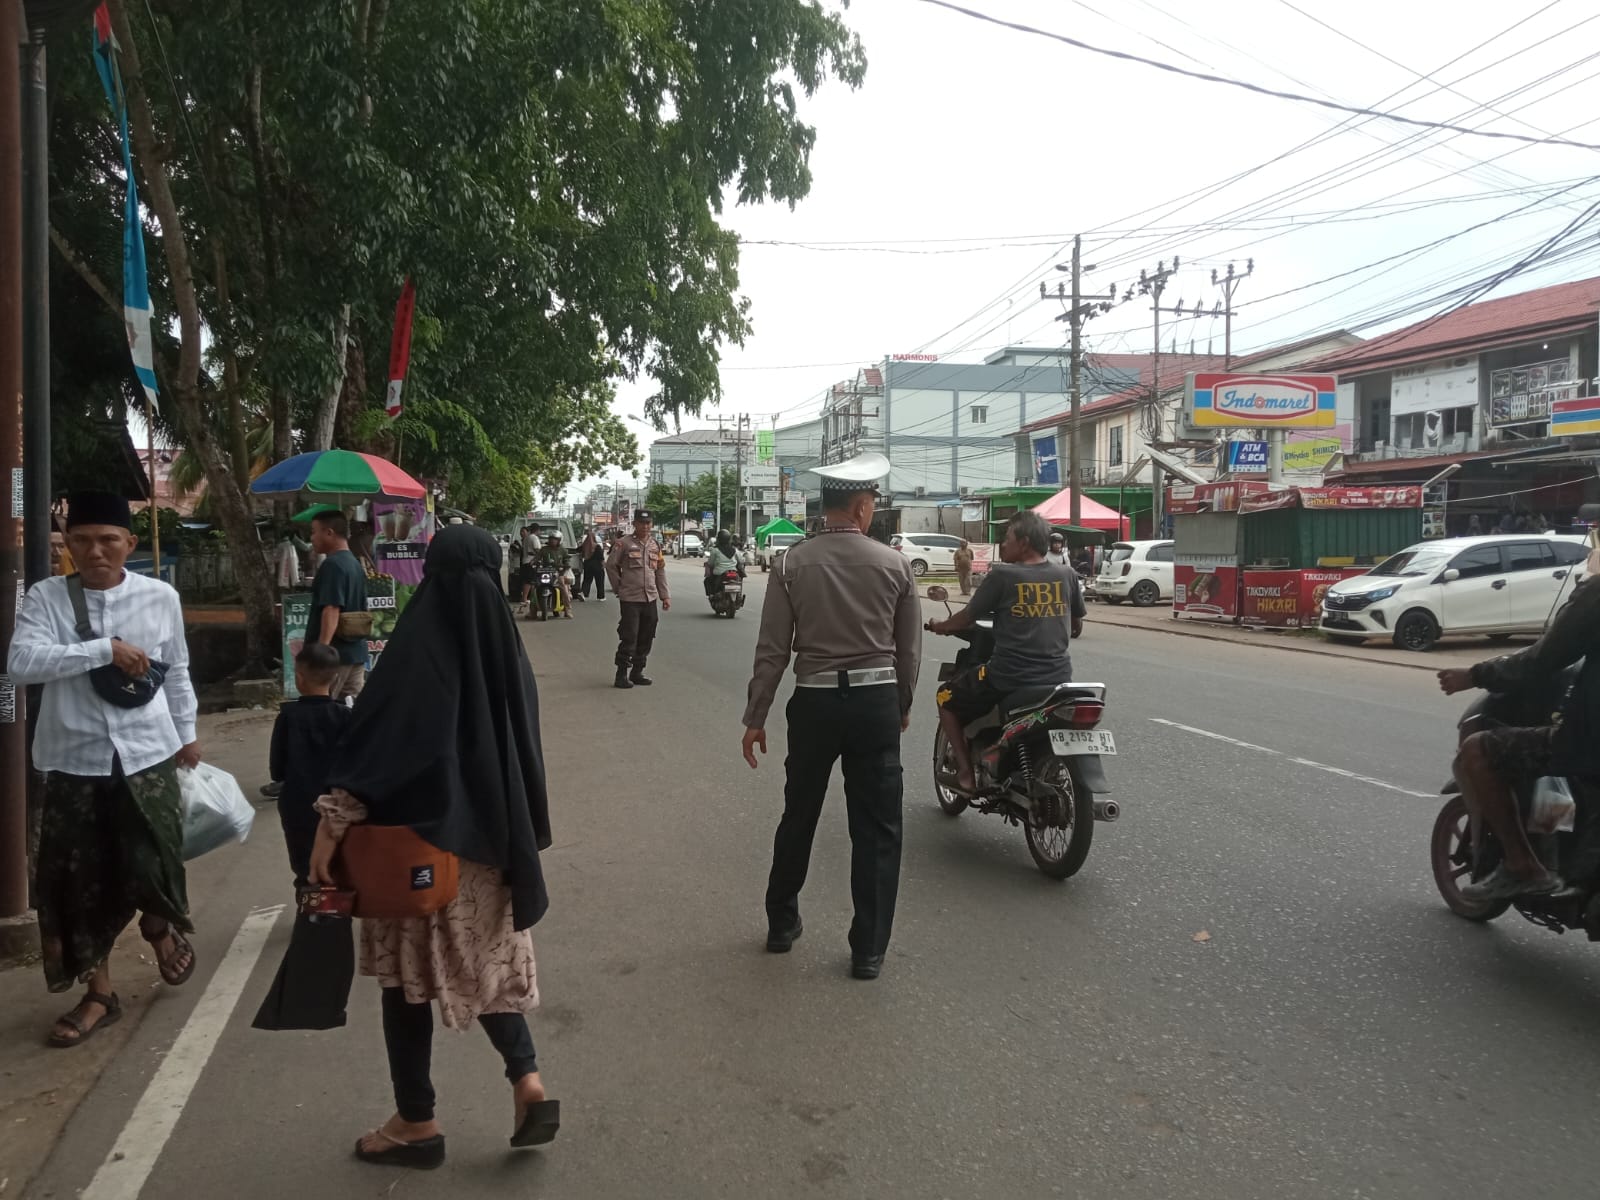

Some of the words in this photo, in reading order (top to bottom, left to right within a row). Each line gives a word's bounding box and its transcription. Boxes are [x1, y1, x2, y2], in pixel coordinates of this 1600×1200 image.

[1220, 390, 1310, 409] Indomaret
[1242, 443, 1262, 452] ATM
[1247, 453, 1265, 461] BCA
[386, 551, 419, 559] BUBBLE
[1303, 573, 1342, 581] TAKOYAKI
[1014, 581, 1062, 605] FBI
[1246, 586, 1281, 597] TAKOYAKI
[291, 603, 306, 613] ES
[1257, 598, 1296, 612] HIKARI
[1051, 732, 1065, 742] KB
[1068, 732, 1094, 743] 2152
